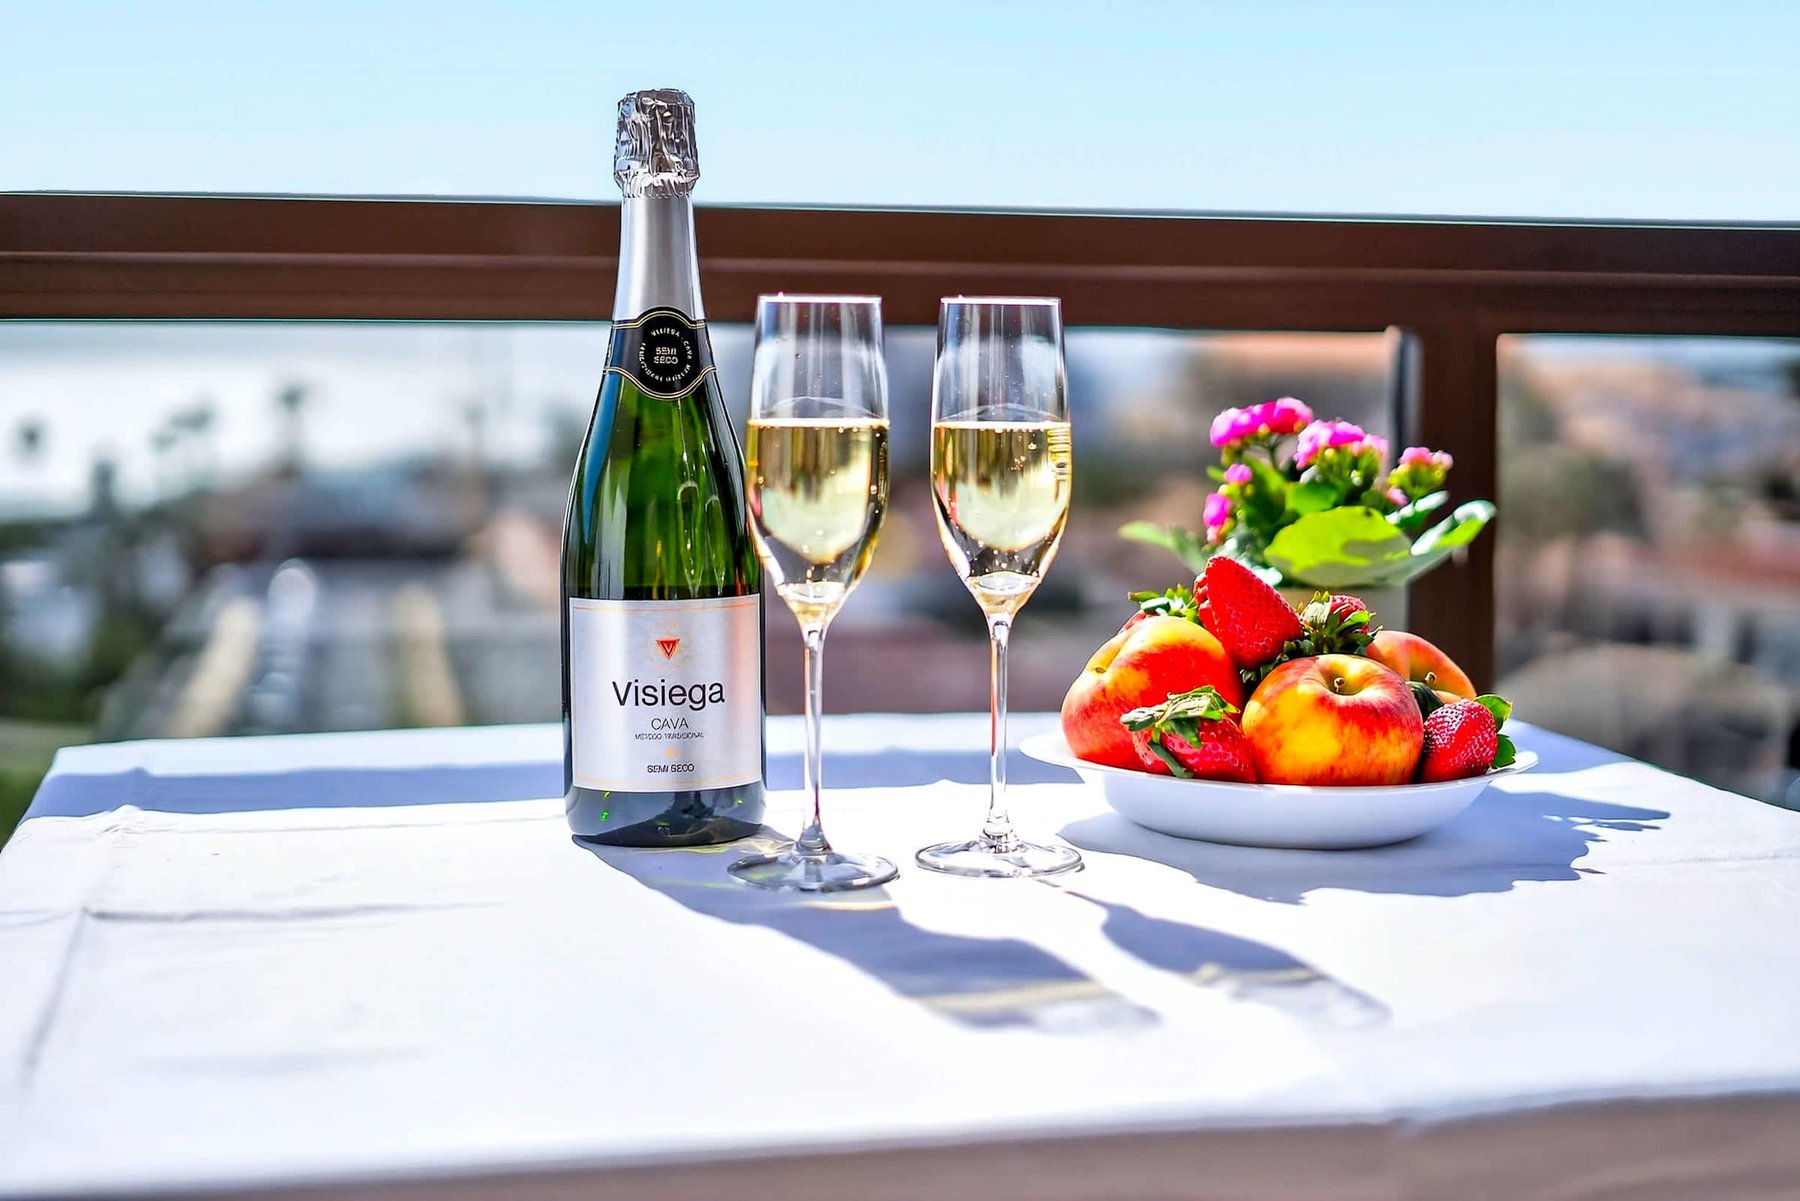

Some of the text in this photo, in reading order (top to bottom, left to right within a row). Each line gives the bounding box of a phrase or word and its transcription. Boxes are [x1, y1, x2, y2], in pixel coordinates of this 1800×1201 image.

[653, 356, 679, 364] SECO
[612, 679, 725, 711] Visiega
[651, 717, 689, 730] CAVA
[647, 763, 695, 774] SEMI SECO
